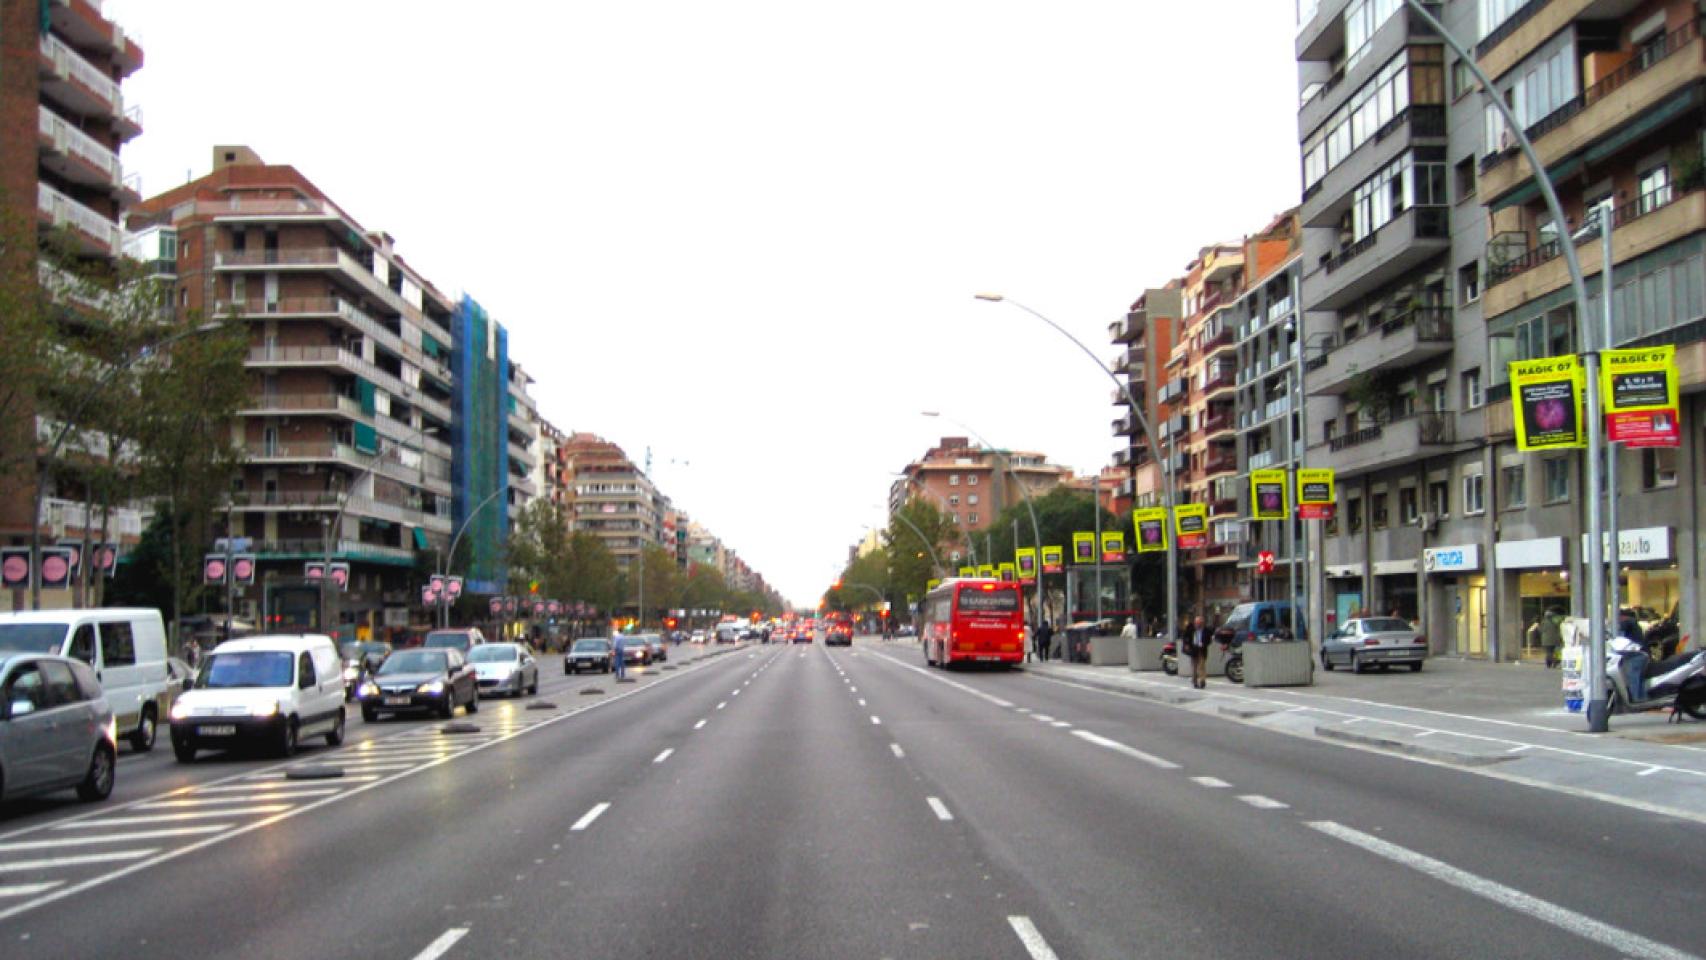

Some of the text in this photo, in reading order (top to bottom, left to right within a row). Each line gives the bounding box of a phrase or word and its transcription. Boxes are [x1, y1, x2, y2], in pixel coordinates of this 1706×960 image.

[1610, 353, 1666, 364] MAGIC 07
[1517, 362, 1571, 375] MAGIC 07
